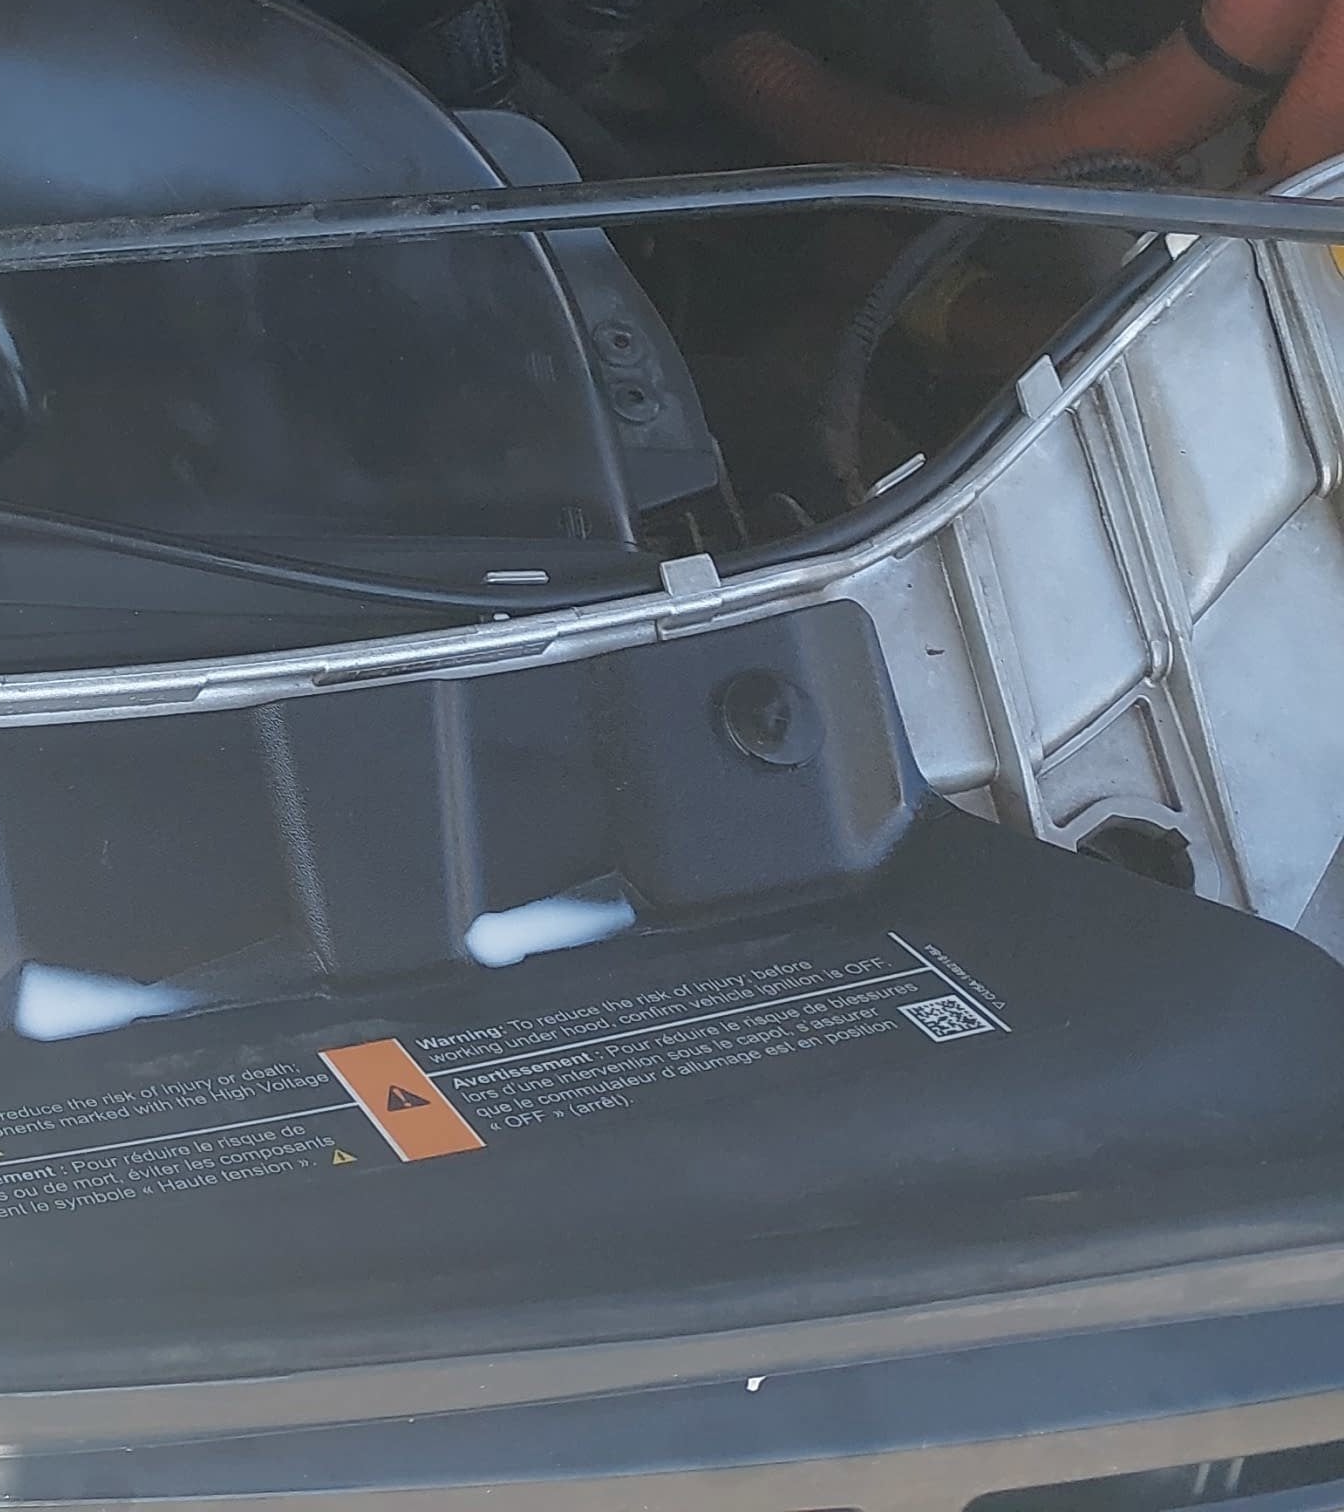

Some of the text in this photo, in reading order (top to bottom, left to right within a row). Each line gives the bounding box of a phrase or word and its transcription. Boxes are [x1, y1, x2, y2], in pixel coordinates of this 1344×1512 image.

[416, 1024, 507, 1050] Warning:
[508, 1019, 534, 1031] To
[536, 1005, 600, 1027] reduce
[602, 998, 633, 1012] the
[636, 990, 671, 1004] risk
[673, 984, 694, 997] of
[752, 961, 813, 981] before
[429, 1041, 504, 1064] working
[505, 1029, 559, 1049] under
[618, 1002, 688, 1025] confirm
[690, 985, 755, 1009] vehicle
[756, 973, 825, 996] ignition
[824, 968, 844, 980] is
[844, 957, 893, 976] OFF.
[452, 1051, 594, 1090] Avertissement
[605, 1040, 651, 1058] Pour
[652, 1024, 720, 1048] réduire
[721, 1019, 741, 1033] le
[743, 1007, 800, 1031] risque
[803, 1001, 828, 1015] de
[828, 982, 919, 1010] blessures
[462, 1007, 880, 1104] lors d'une intervention sous le capot, s'assurer
[476, 1018, 898, 1119] que le commutateur d'allumage est en position
[0, 1101, 64, 1122] reduce
[67, 1097, 98, 1110] the
[102, 1089, 136, 1105] risk
[140, 1085, 158, 1099] of
[161, 1078, 212, 1096] injury
[217, 1074, 235, 1086] or
[60, 1107, 130, 1128] marked
[134, 1098, 173, 1115] with
[176, 1094, 208, 1108] the
[211, 1086, 256, 1102] High
[257, 1072, 330, 1093] Voltage
[504, 1109, 546, 1128] OFF
[13, 1185, 39, 1199] ou
[43, 1182, 68, 1195] de
[73, 1172, 124, 1190] mort,
[128, 1163, 180, 1180] éviter
[184, 1158, 216, 1172] les
[219, 1135, 336, 1165] composants
[71, 1156, 118, 1174] Pour
[123, 1144, 191, 1165] réduire
[193, 1141, 213, 1153] le
[217, 1131, 277, 1149] risque
[281, 1125, 306, 1137] de
[30, 1200, 50, 1214] le
[54, 1187, 137, 1211] symbole
[156, 1172, 218, 1194] Haute
[221, 1161, 294, 1182] tension
